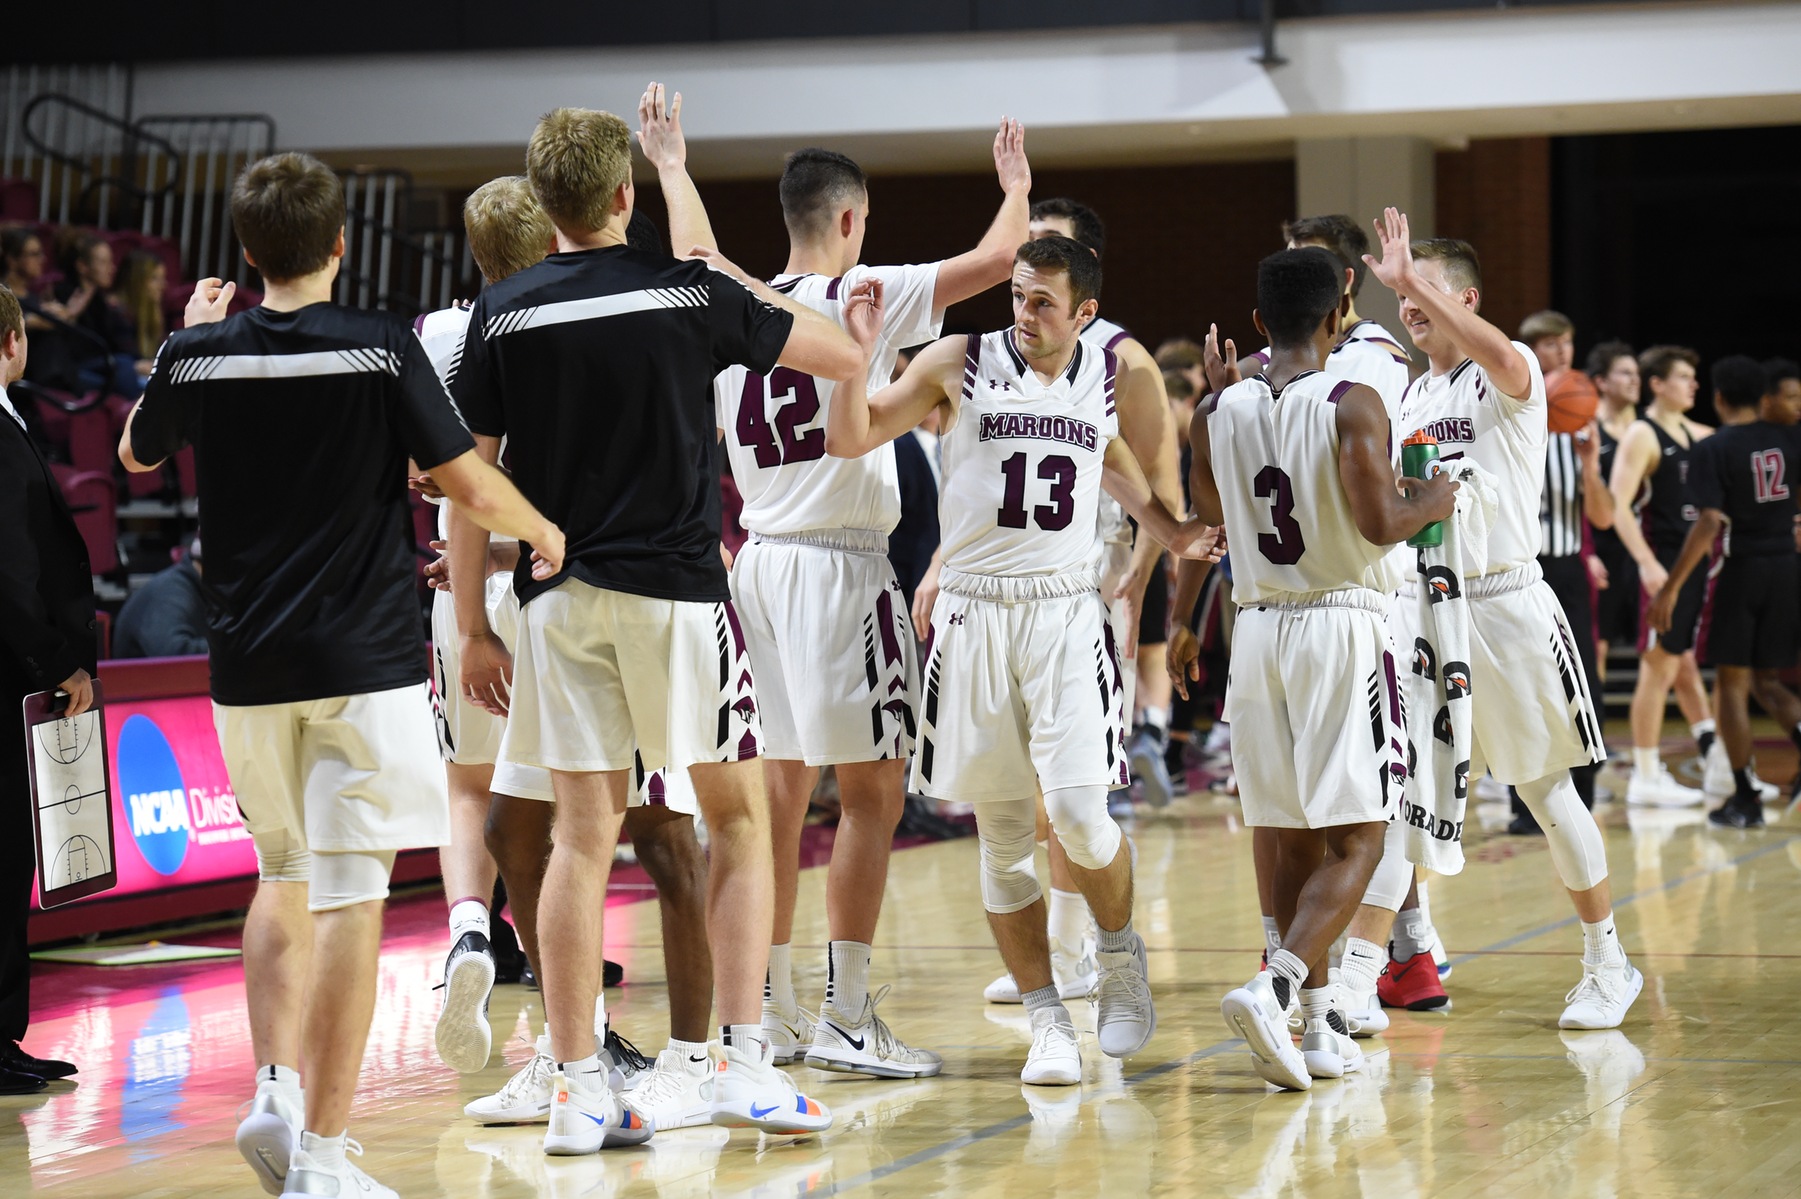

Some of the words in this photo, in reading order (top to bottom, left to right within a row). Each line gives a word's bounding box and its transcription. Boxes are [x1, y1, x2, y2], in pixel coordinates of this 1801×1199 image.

[736, 366, 826, 469] 42
[979, 412, 1098, 453] MAROONS
[1412, 417, 1476, 445] OONS
[997, 451, 1078, 531] 13
[1751, 447, 1791, 504] 12
[1253, 465, 1306, 565] 3
[129, 788, 190, 838] NCAA
